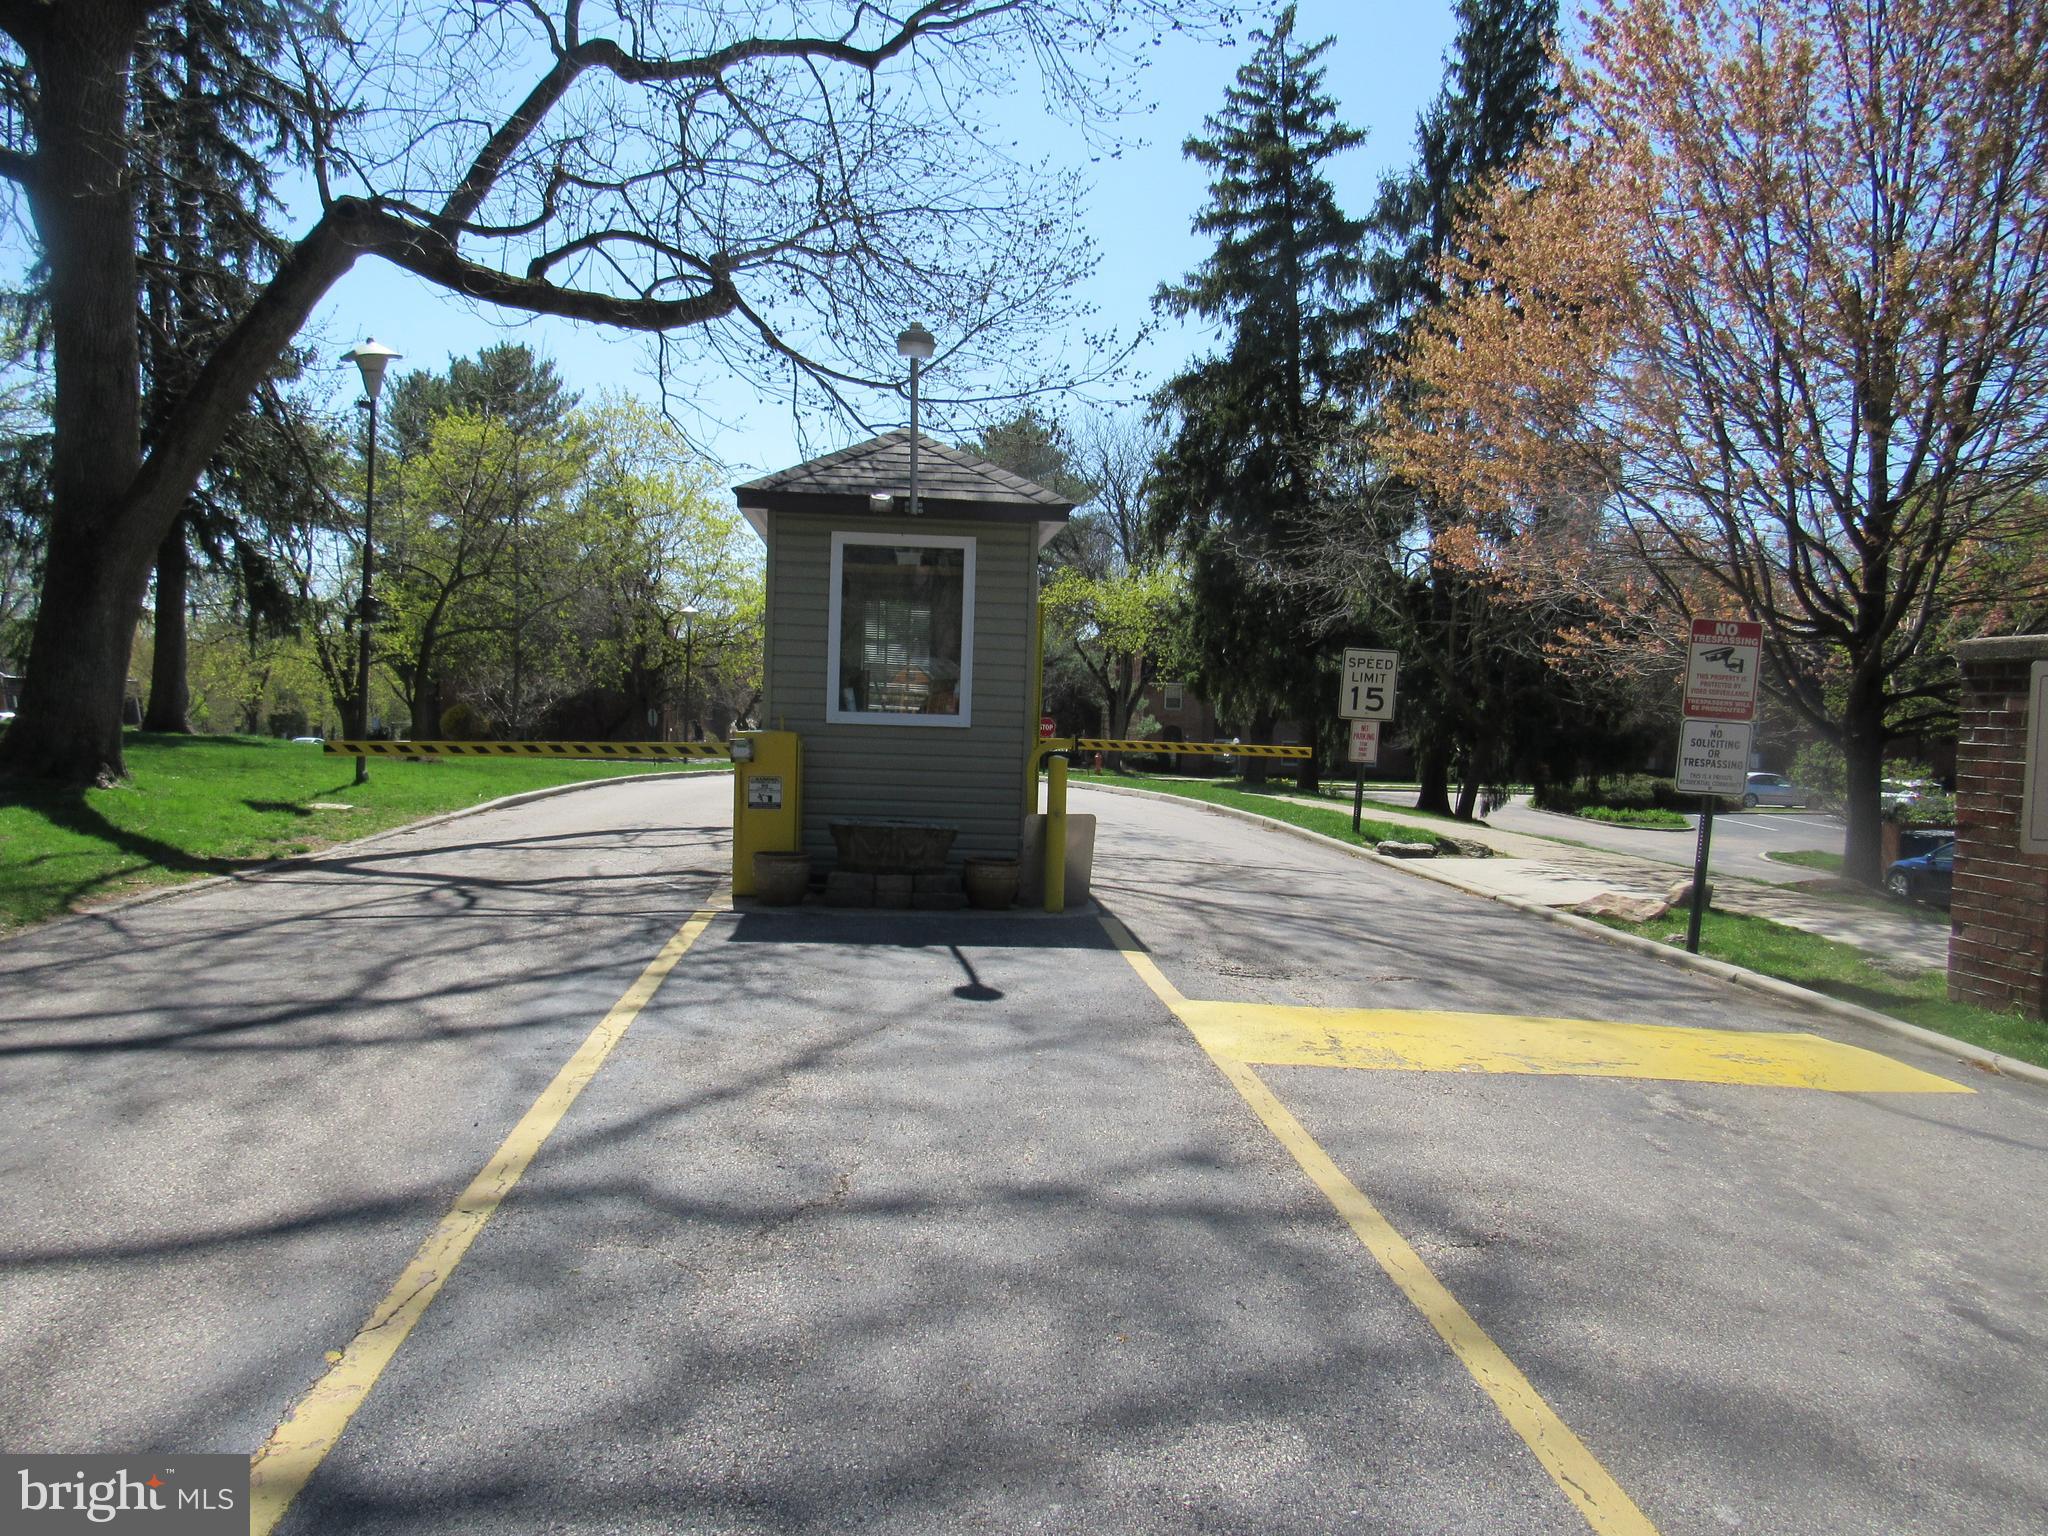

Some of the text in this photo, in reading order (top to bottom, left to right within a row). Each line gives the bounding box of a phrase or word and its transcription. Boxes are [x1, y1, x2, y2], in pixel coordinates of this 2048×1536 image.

[1715, 623, 1738, 636] NO
[1693, 634, 1759, 646] TRESPASSING
[1349, 657, 1393, 670] SPEED
[1351, 672, 1387, 684] LIMIT
[1351, 686, 1385, 712] 15
[1710, 729, 1723, 738] NO
[1690, 738, 1741, 750] SOLICITING
[1708, 749, 1720, 758] OR
[1683, 757, 1743, 770] TRESPASSING
